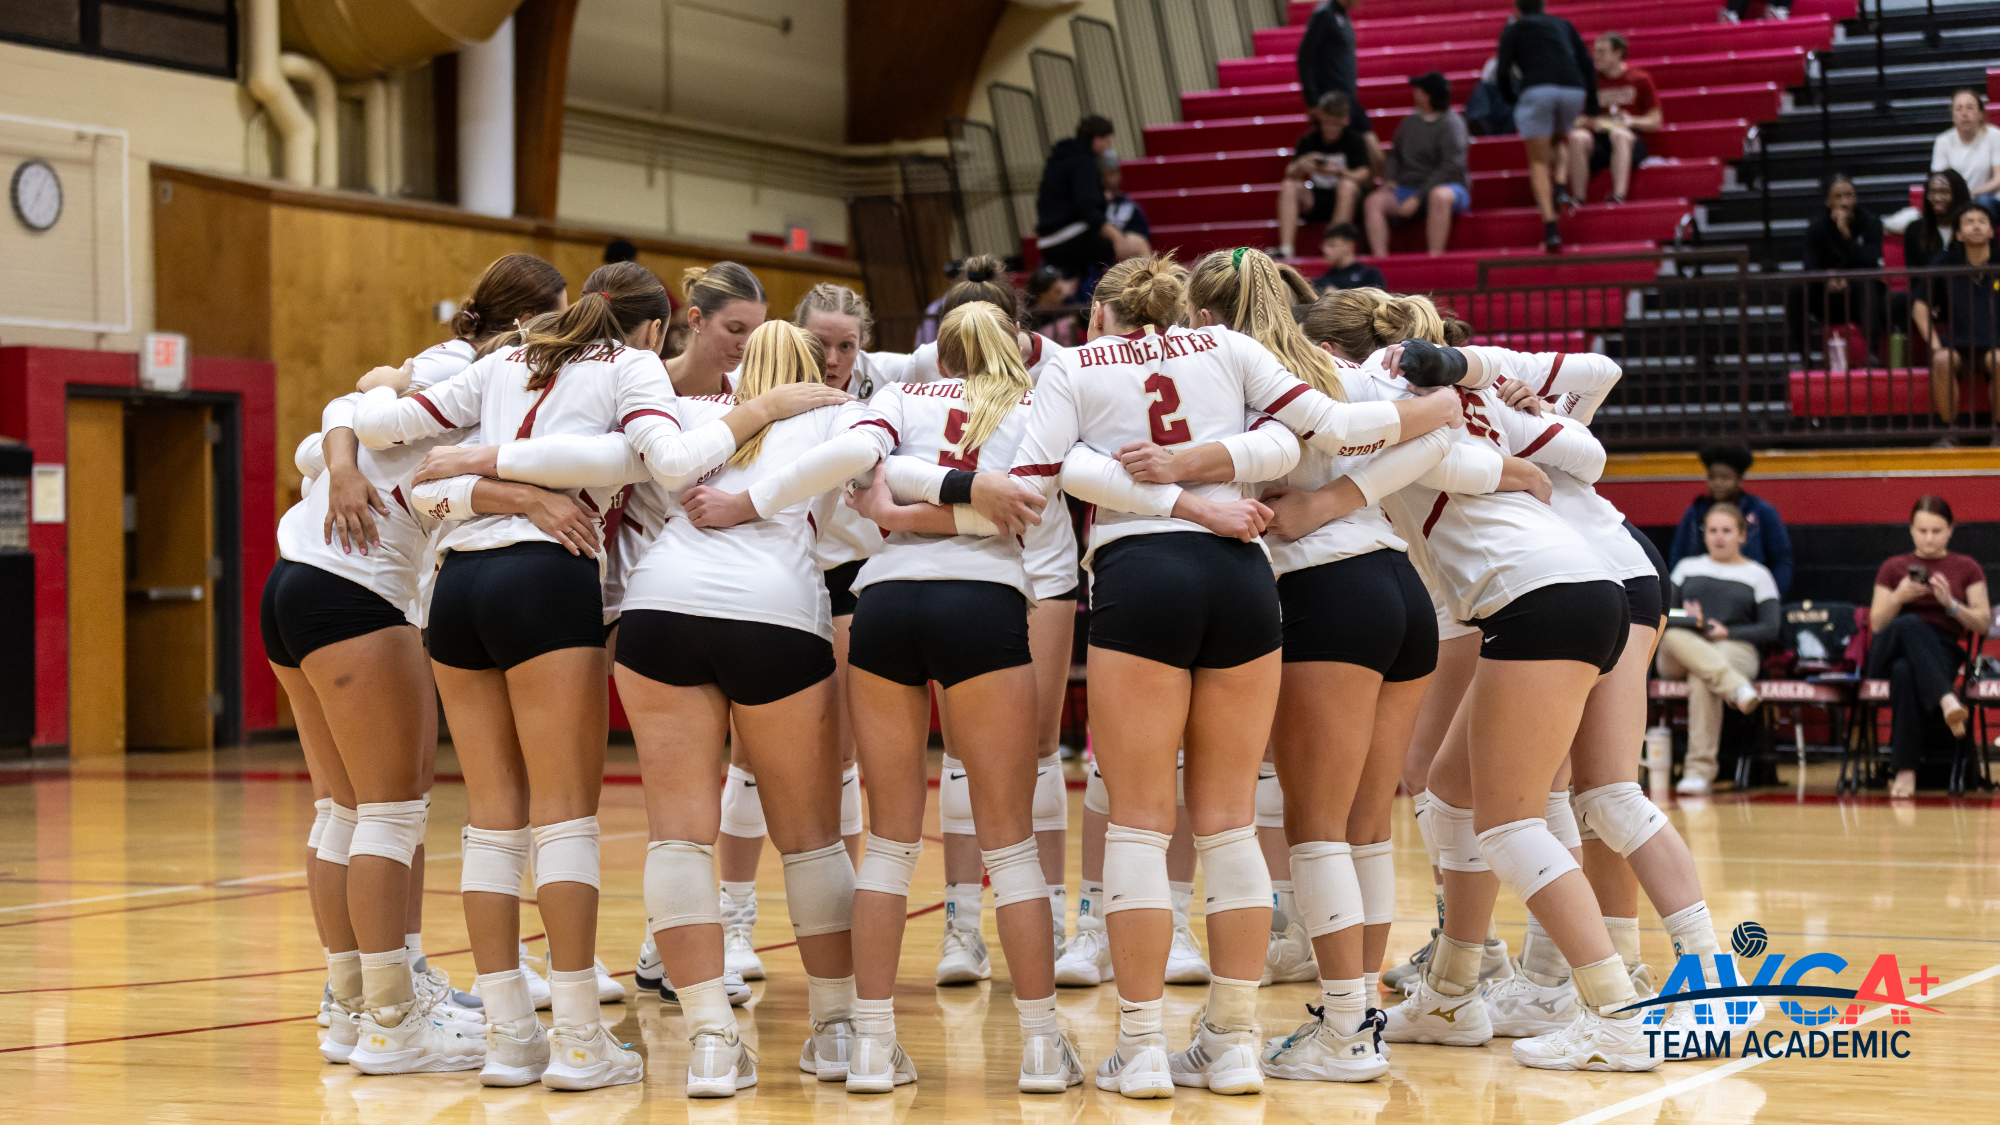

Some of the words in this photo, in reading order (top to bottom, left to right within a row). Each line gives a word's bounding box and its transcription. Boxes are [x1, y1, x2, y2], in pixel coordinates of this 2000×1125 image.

[514, 369, 559, 442] 7
[1142, 371, 1194, 447] 2
[1337, 439, 1386, 456] EAGLES
